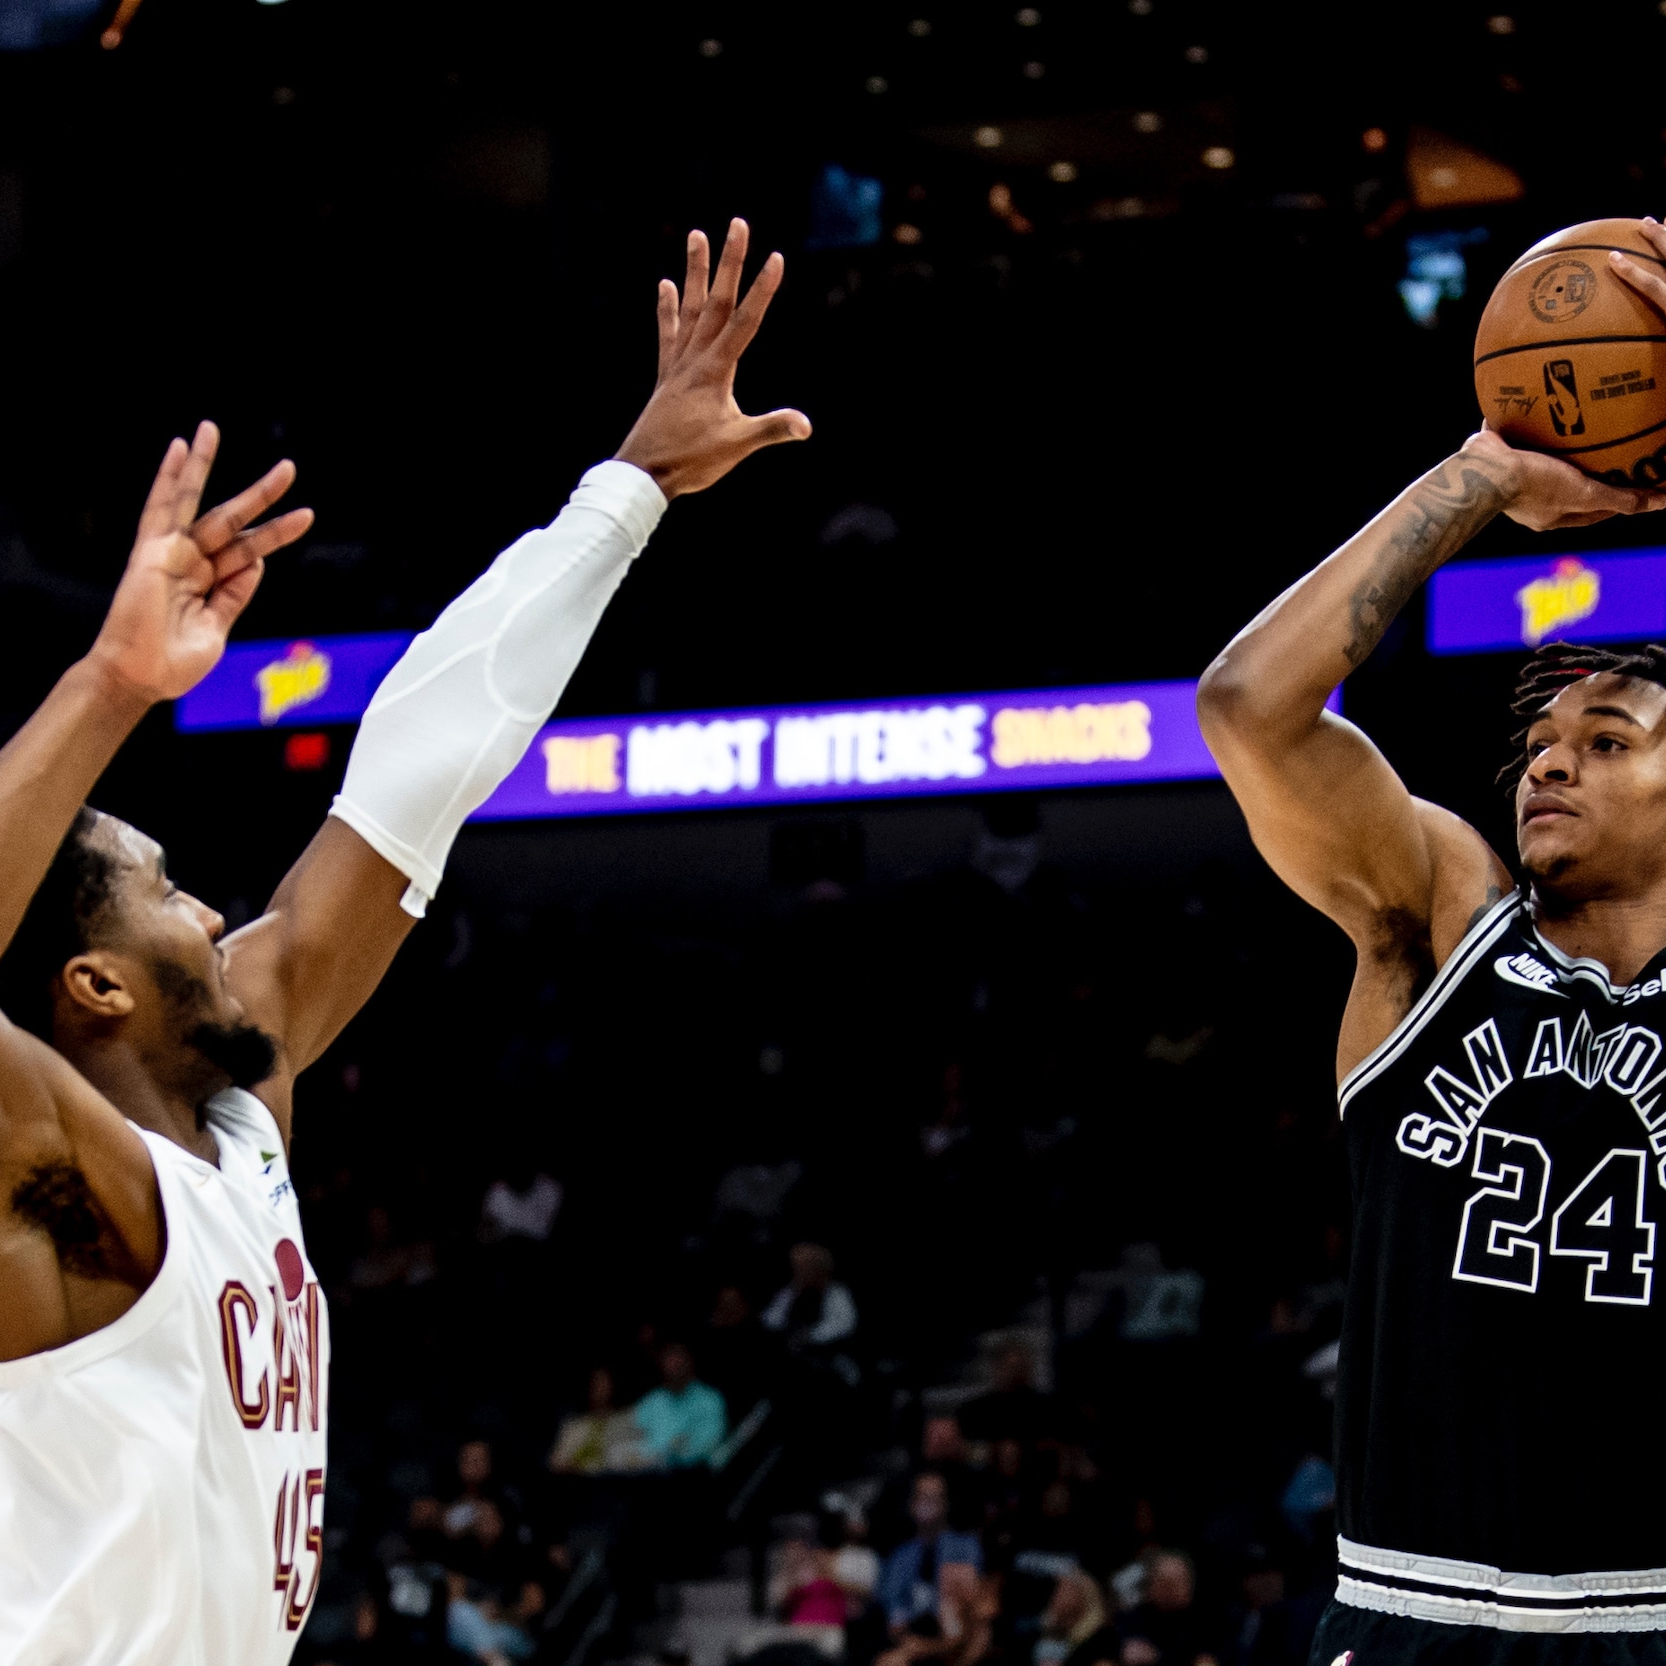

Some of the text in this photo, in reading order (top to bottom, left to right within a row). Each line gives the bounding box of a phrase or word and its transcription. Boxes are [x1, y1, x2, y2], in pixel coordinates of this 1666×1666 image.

[626, 717, 771, 797] MOST
[773, 703, 988, 789] INTENSE
[1508, 952, 1560, 987] NIKE
[1395, 1017, 1514, 1168] SAN
[1451, 1125, 1657, 1306] 24
